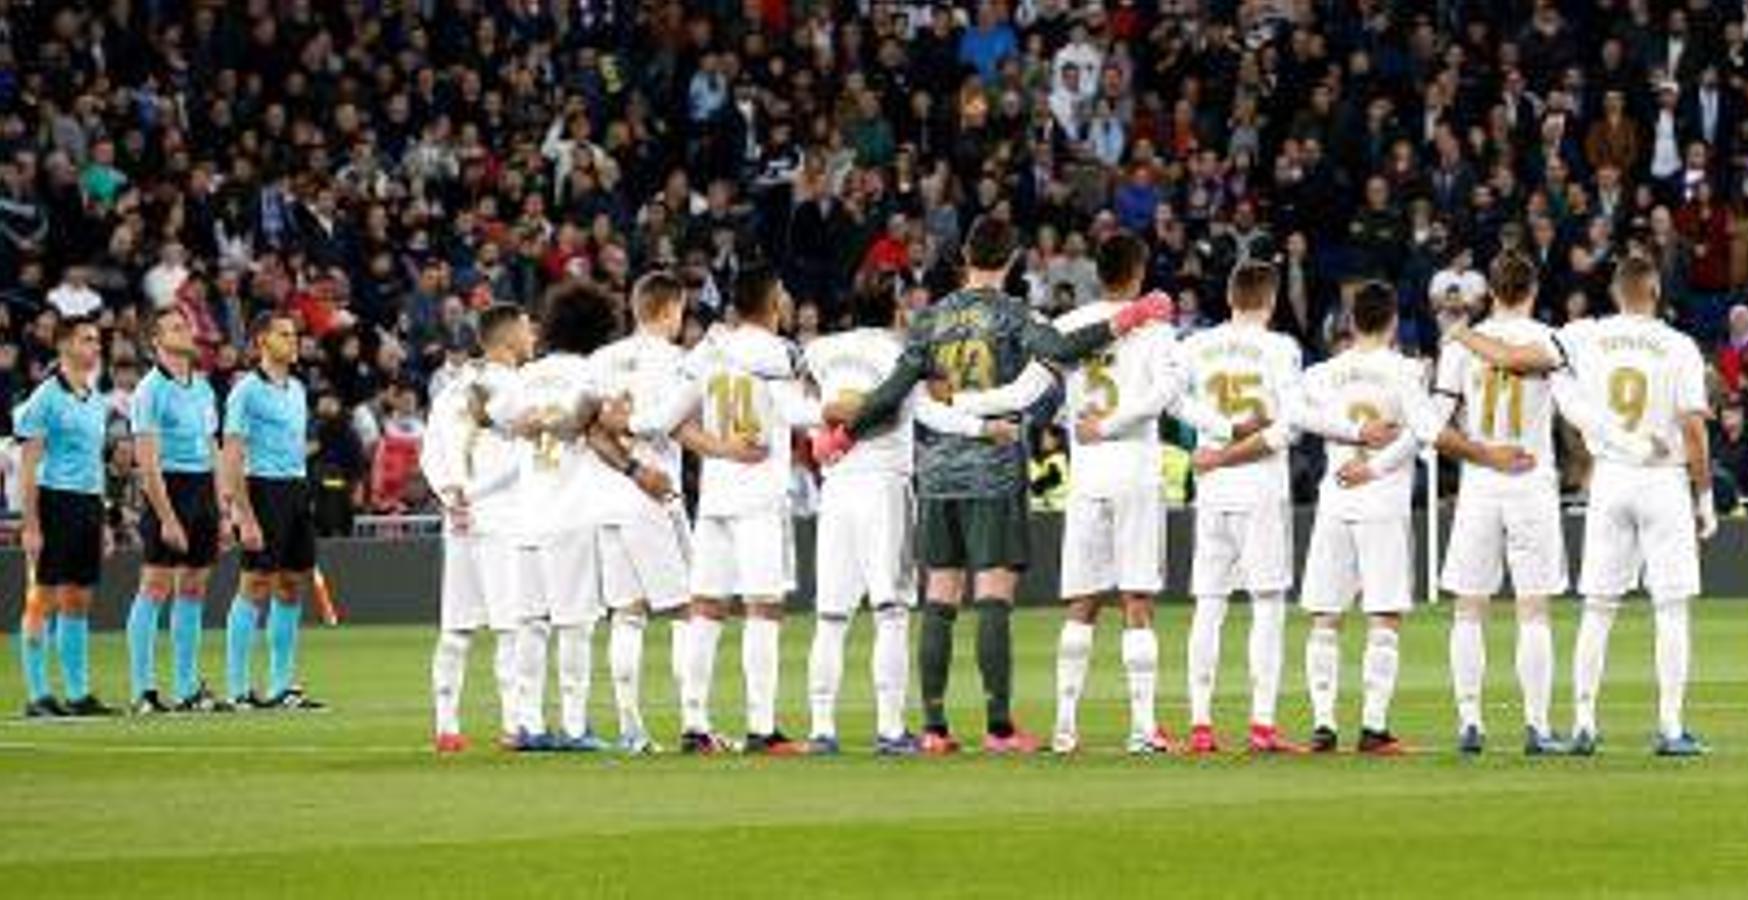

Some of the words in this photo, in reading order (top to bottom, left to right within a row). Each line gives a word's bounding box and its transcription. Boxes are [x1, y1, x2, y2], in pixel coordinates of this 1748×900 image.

[1206, 371, 1267, 424] 15
[1482, 363, 1523, 440] 11
[1607, 366, 1648, 432] 9
